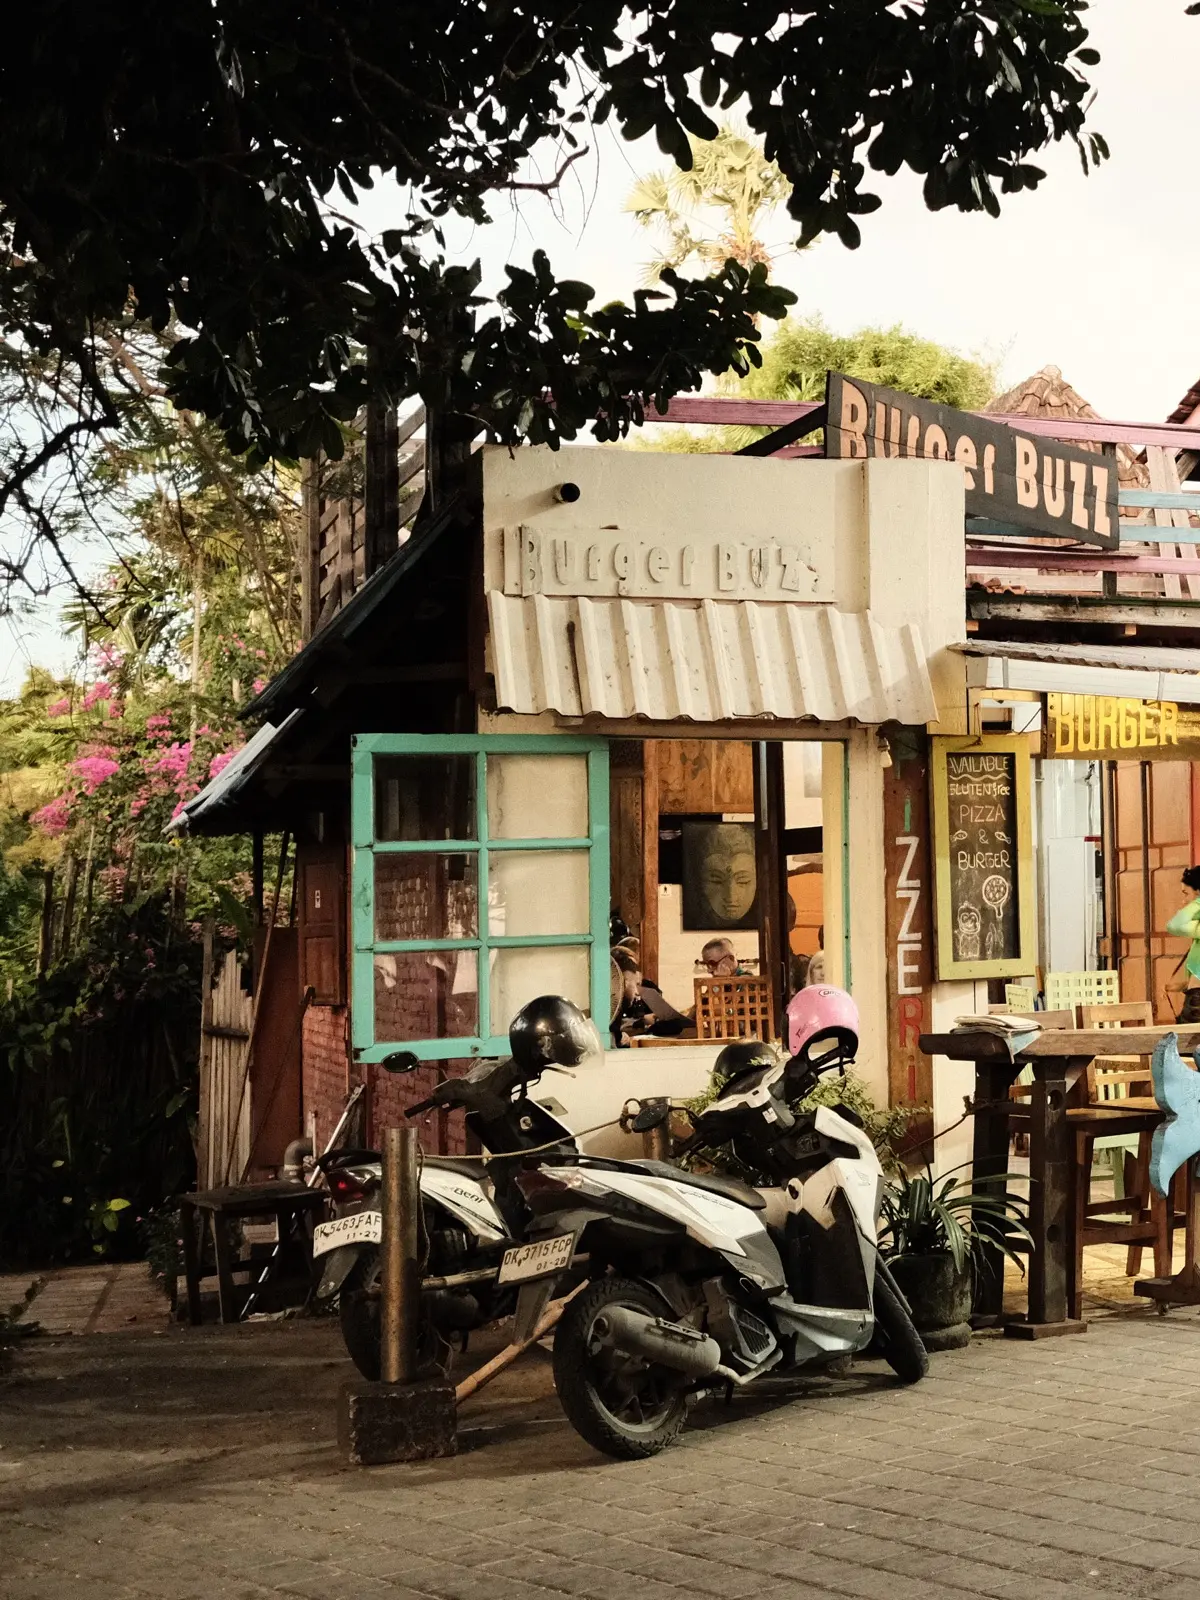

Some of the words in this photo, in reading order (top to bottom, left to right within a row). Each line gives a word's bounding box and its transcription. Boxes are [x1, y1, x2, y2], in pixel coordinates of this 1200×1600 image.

[1054, 693, 1179, 753] BURGER
[949, 755, 1009, 774] AVAILABLE
[960, 804, 1006, 824] PIZZA
[978, 828, 989, 844] &
[957, 849, 1011, 871] BURGER
[522, 1243, 550, 1261] 3715
